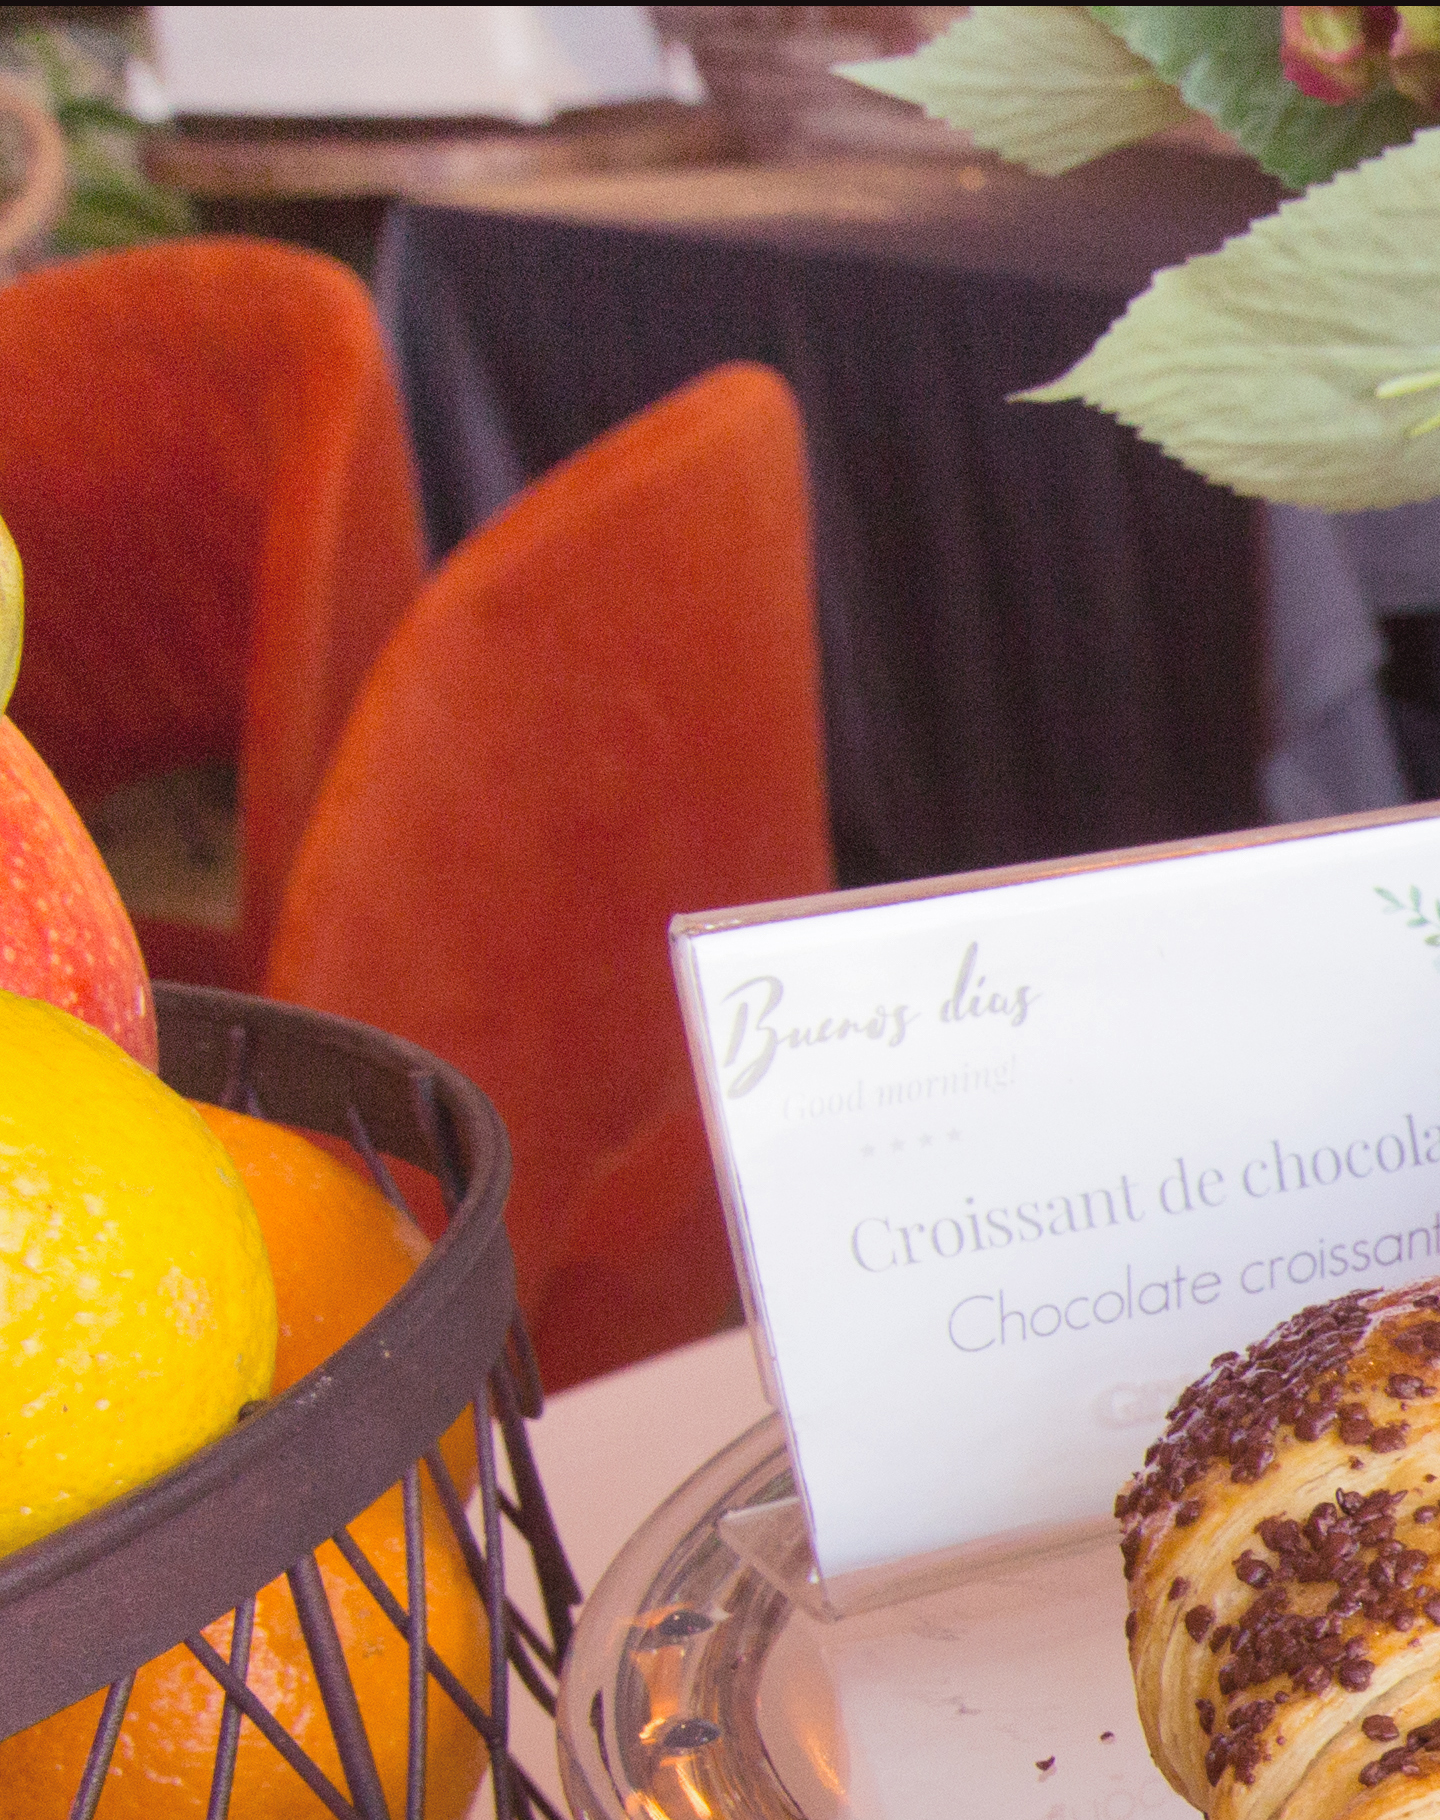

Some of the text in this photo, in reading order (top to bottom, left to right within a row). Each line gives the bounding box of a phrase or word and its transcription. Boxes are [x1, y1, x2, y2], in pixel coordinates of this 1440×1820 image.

[720, 974, 922, 1100] Buenos
[781, 1053, 1018, 1121] Good morning!
[849, 1174, 1147, 1275] Croissant
[1156, 1156, 1226, 1219] de
[947, 1263, 1222, 1353] Chocolate
